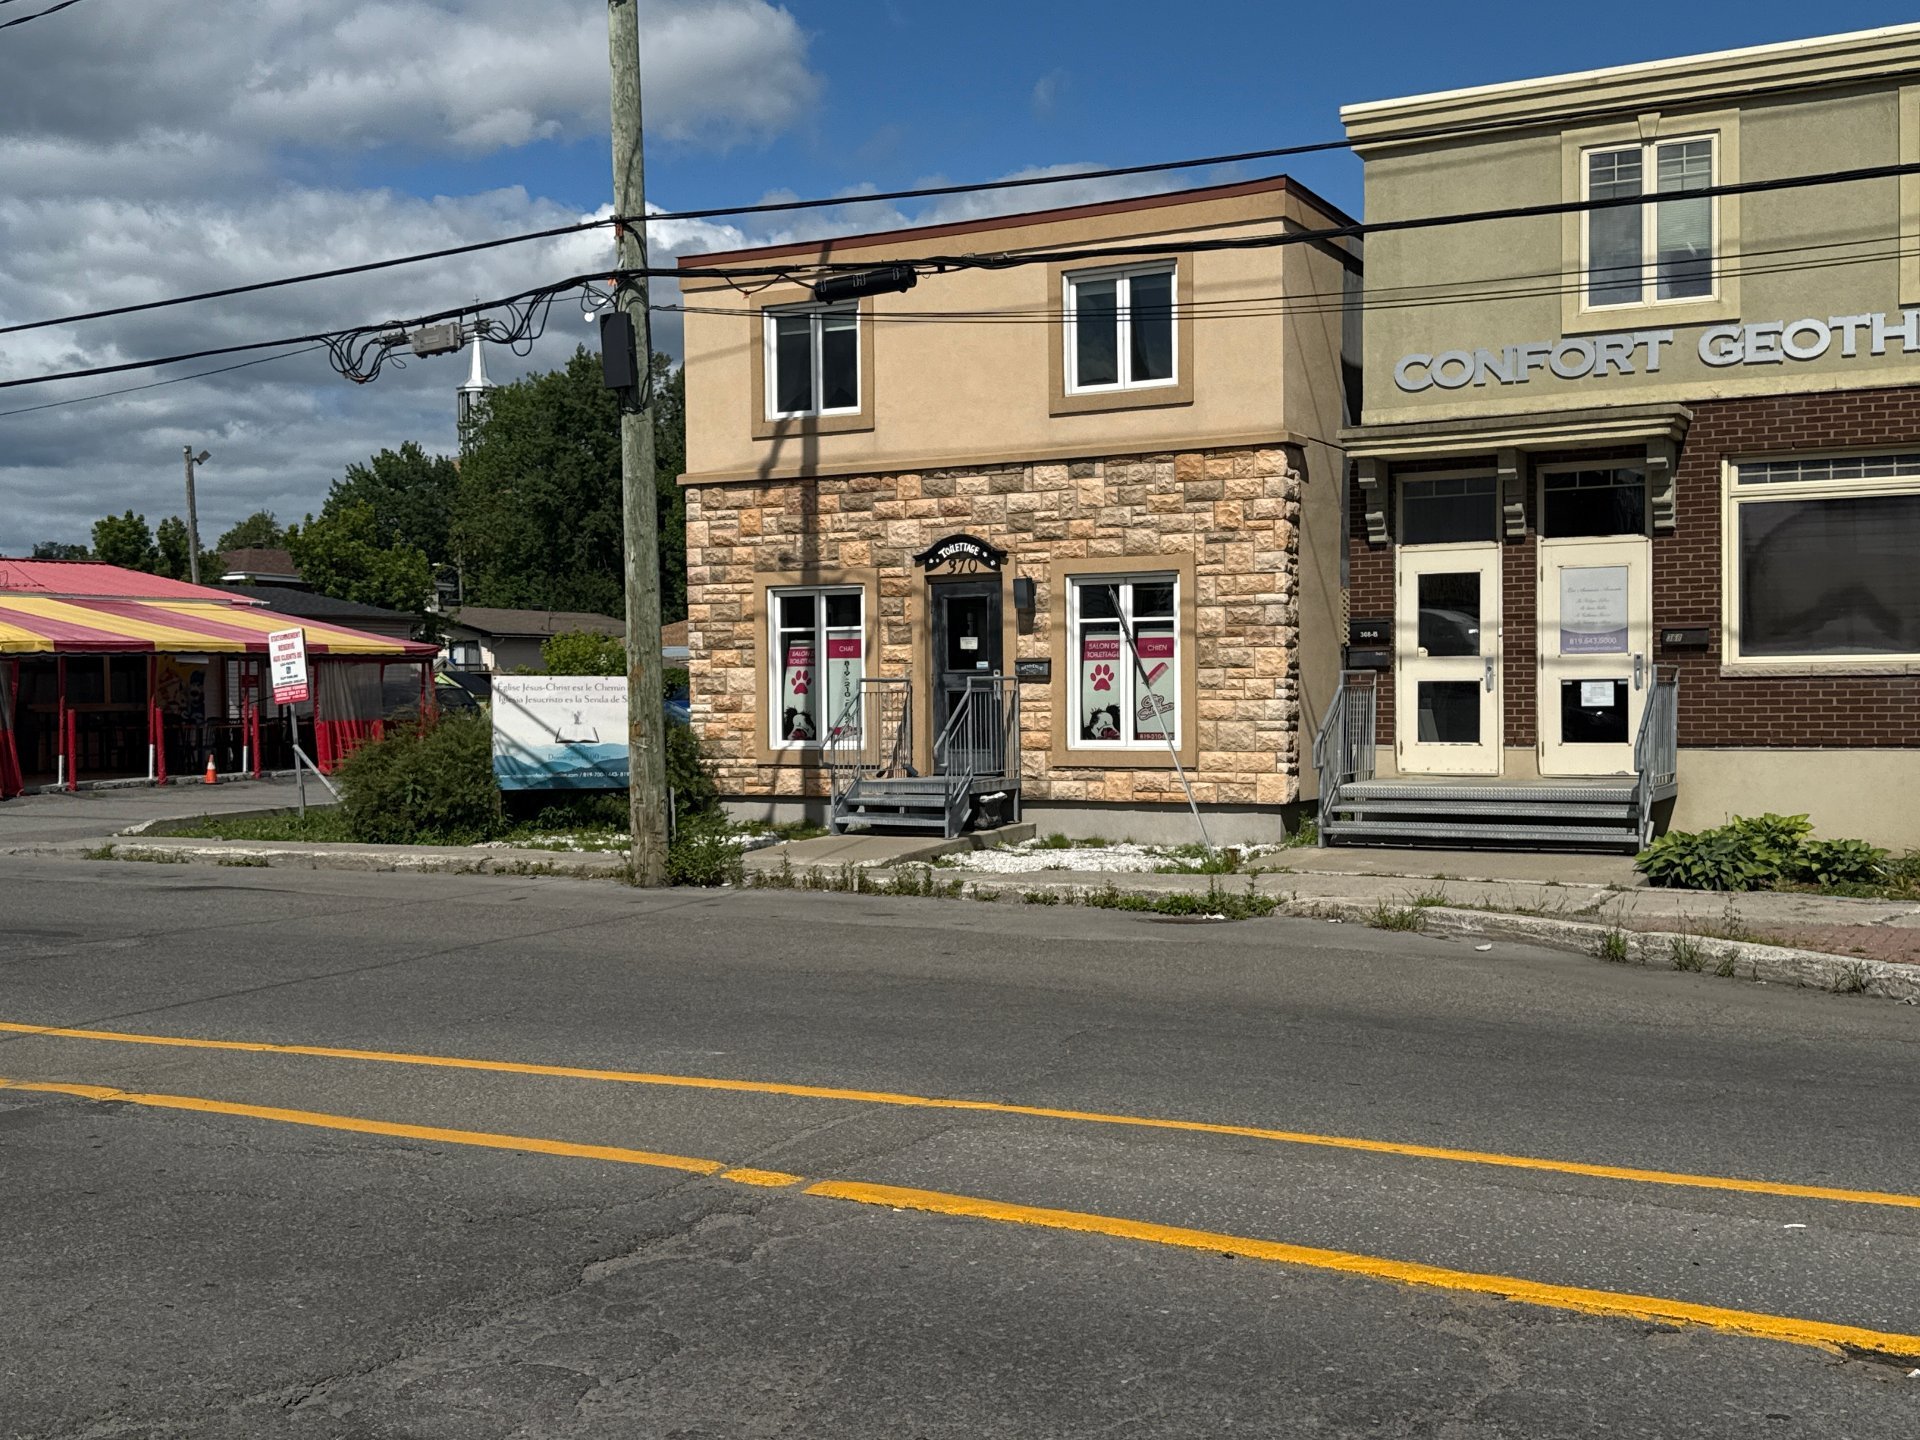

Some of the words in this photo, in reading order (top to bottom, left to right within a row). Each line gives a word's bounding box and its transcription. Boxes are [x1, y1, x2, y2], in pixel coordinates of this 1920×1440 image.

[1393, 328, 1674, 392] CONFORT
[947, 558, 978, 575] 370
[1089, 642, 1109, 650] SALON
[497, 681, 521, 694] Église
[522, 682, 571, 693] Jésus-Christ
[572, 684, 584, 692] est
[585, 682, 592, 692] le
[594, 682, 626, 692] Chemin
[525, 694, 562, 704] Jesucristo
[575, 694, 583, 704] la
[584, 694, 609, 704] Senda
[610, 694, 620, 704] de
